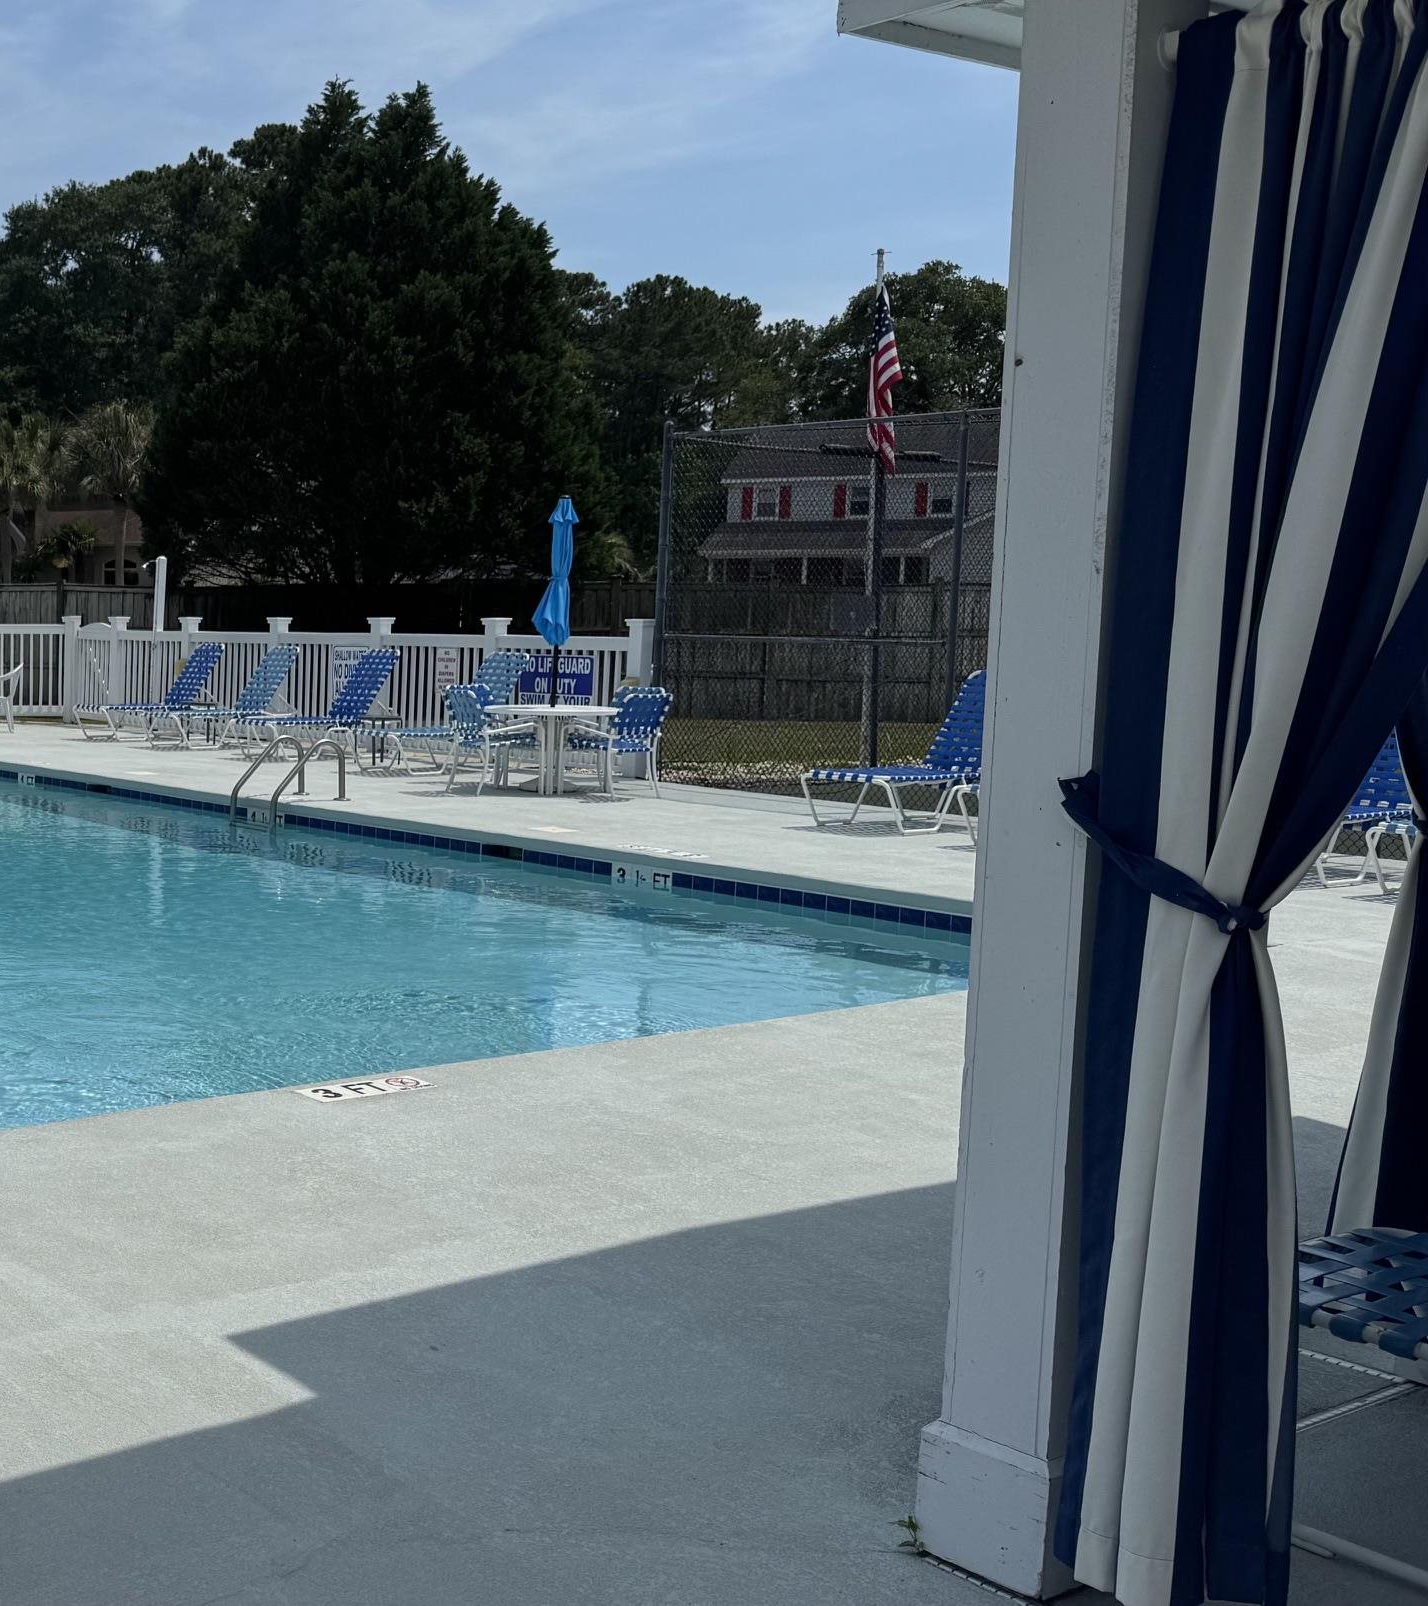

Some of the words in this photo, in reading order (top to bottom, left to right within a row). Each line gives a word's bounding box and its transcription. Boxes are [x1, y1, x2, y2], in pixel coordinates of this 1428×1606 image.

[538, 657, 591, 675] LIFGUARD
[534, 677, 548, 693] ON
[520, 693, 545, 705] SWIM
[563, 696, 591, 706] YOUR
[653, 872, 671, 888] FT
[310, 1088, 343, 1099] 3
[341, 1081, 387, 1095] FT
